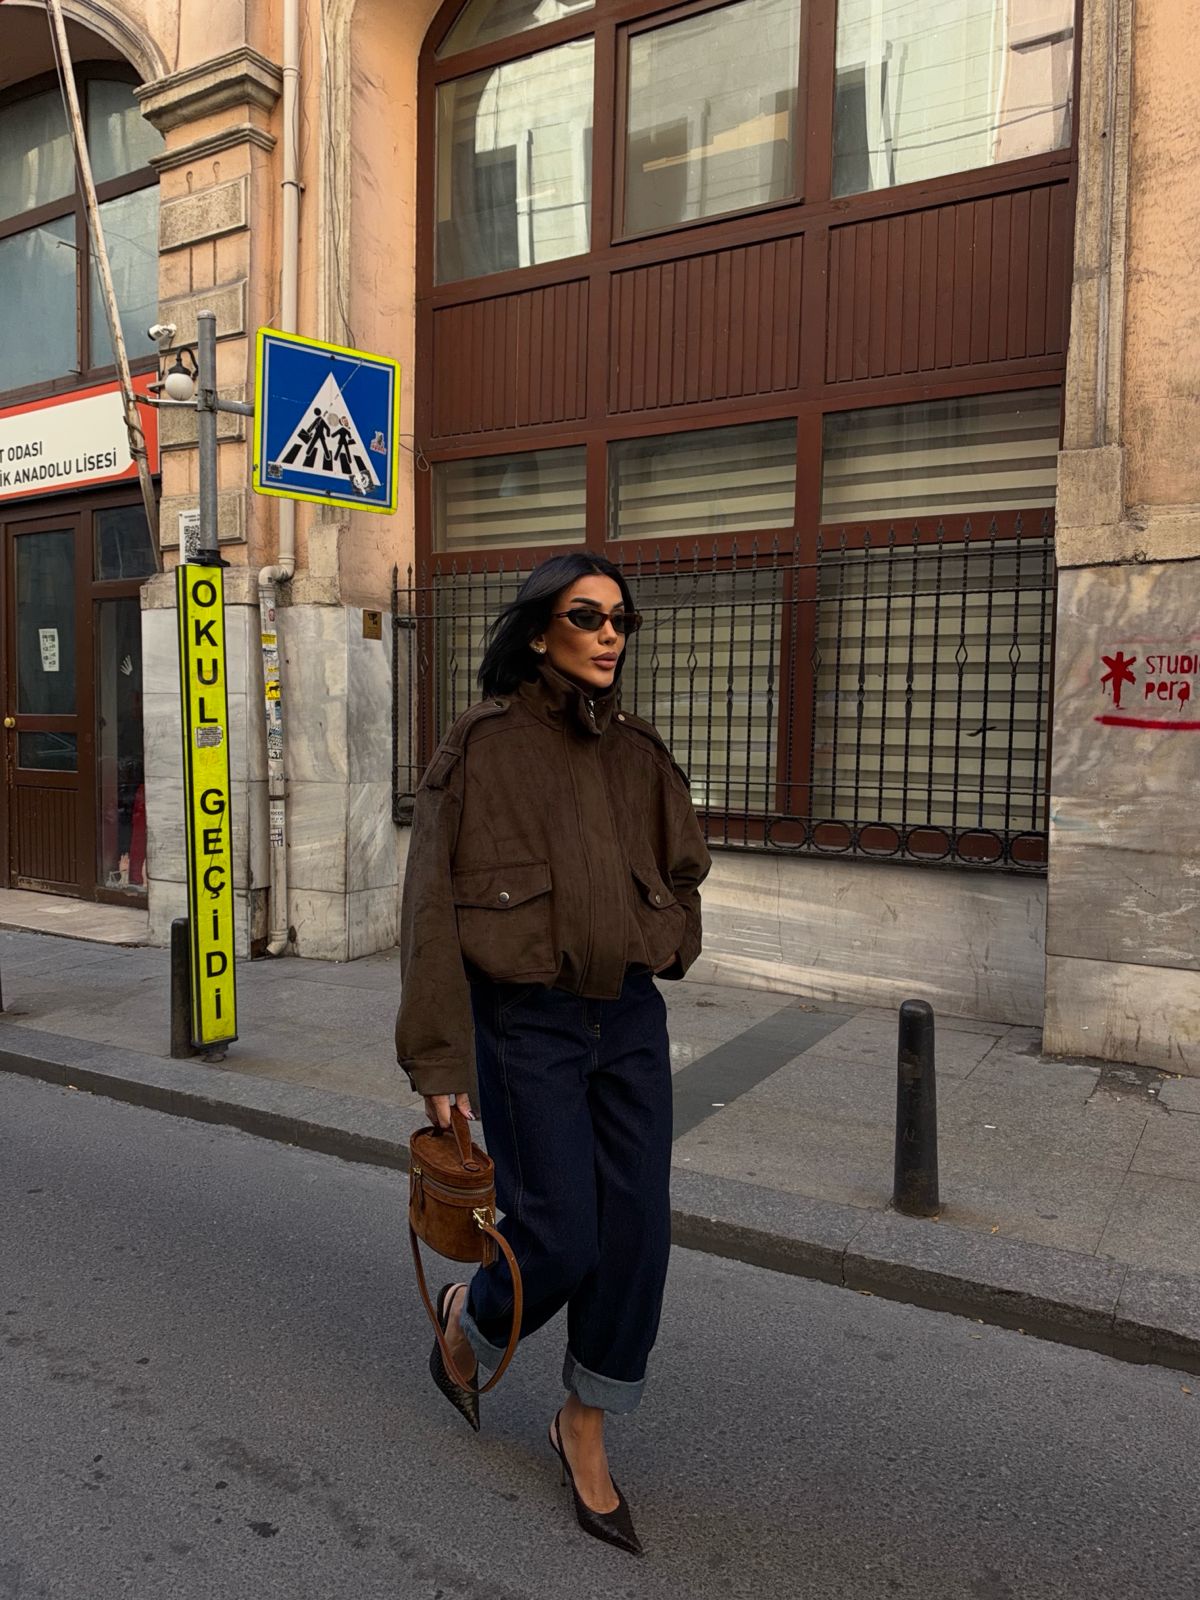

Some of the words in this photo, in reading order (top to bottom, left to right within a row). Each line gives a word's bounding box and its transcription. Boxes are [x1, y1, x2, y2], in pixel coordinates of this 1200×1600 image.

[8, 441, 43, 461] ODASI
[14, 460, 72, 485] ANADOLU
[76, 448, 117, 474] LİSESİ
[191, 579, 218, 723] OKUL
[1145, 654, 1200, 675] STUDI
[200, 788, 228, 1020] GEÇİDİ
